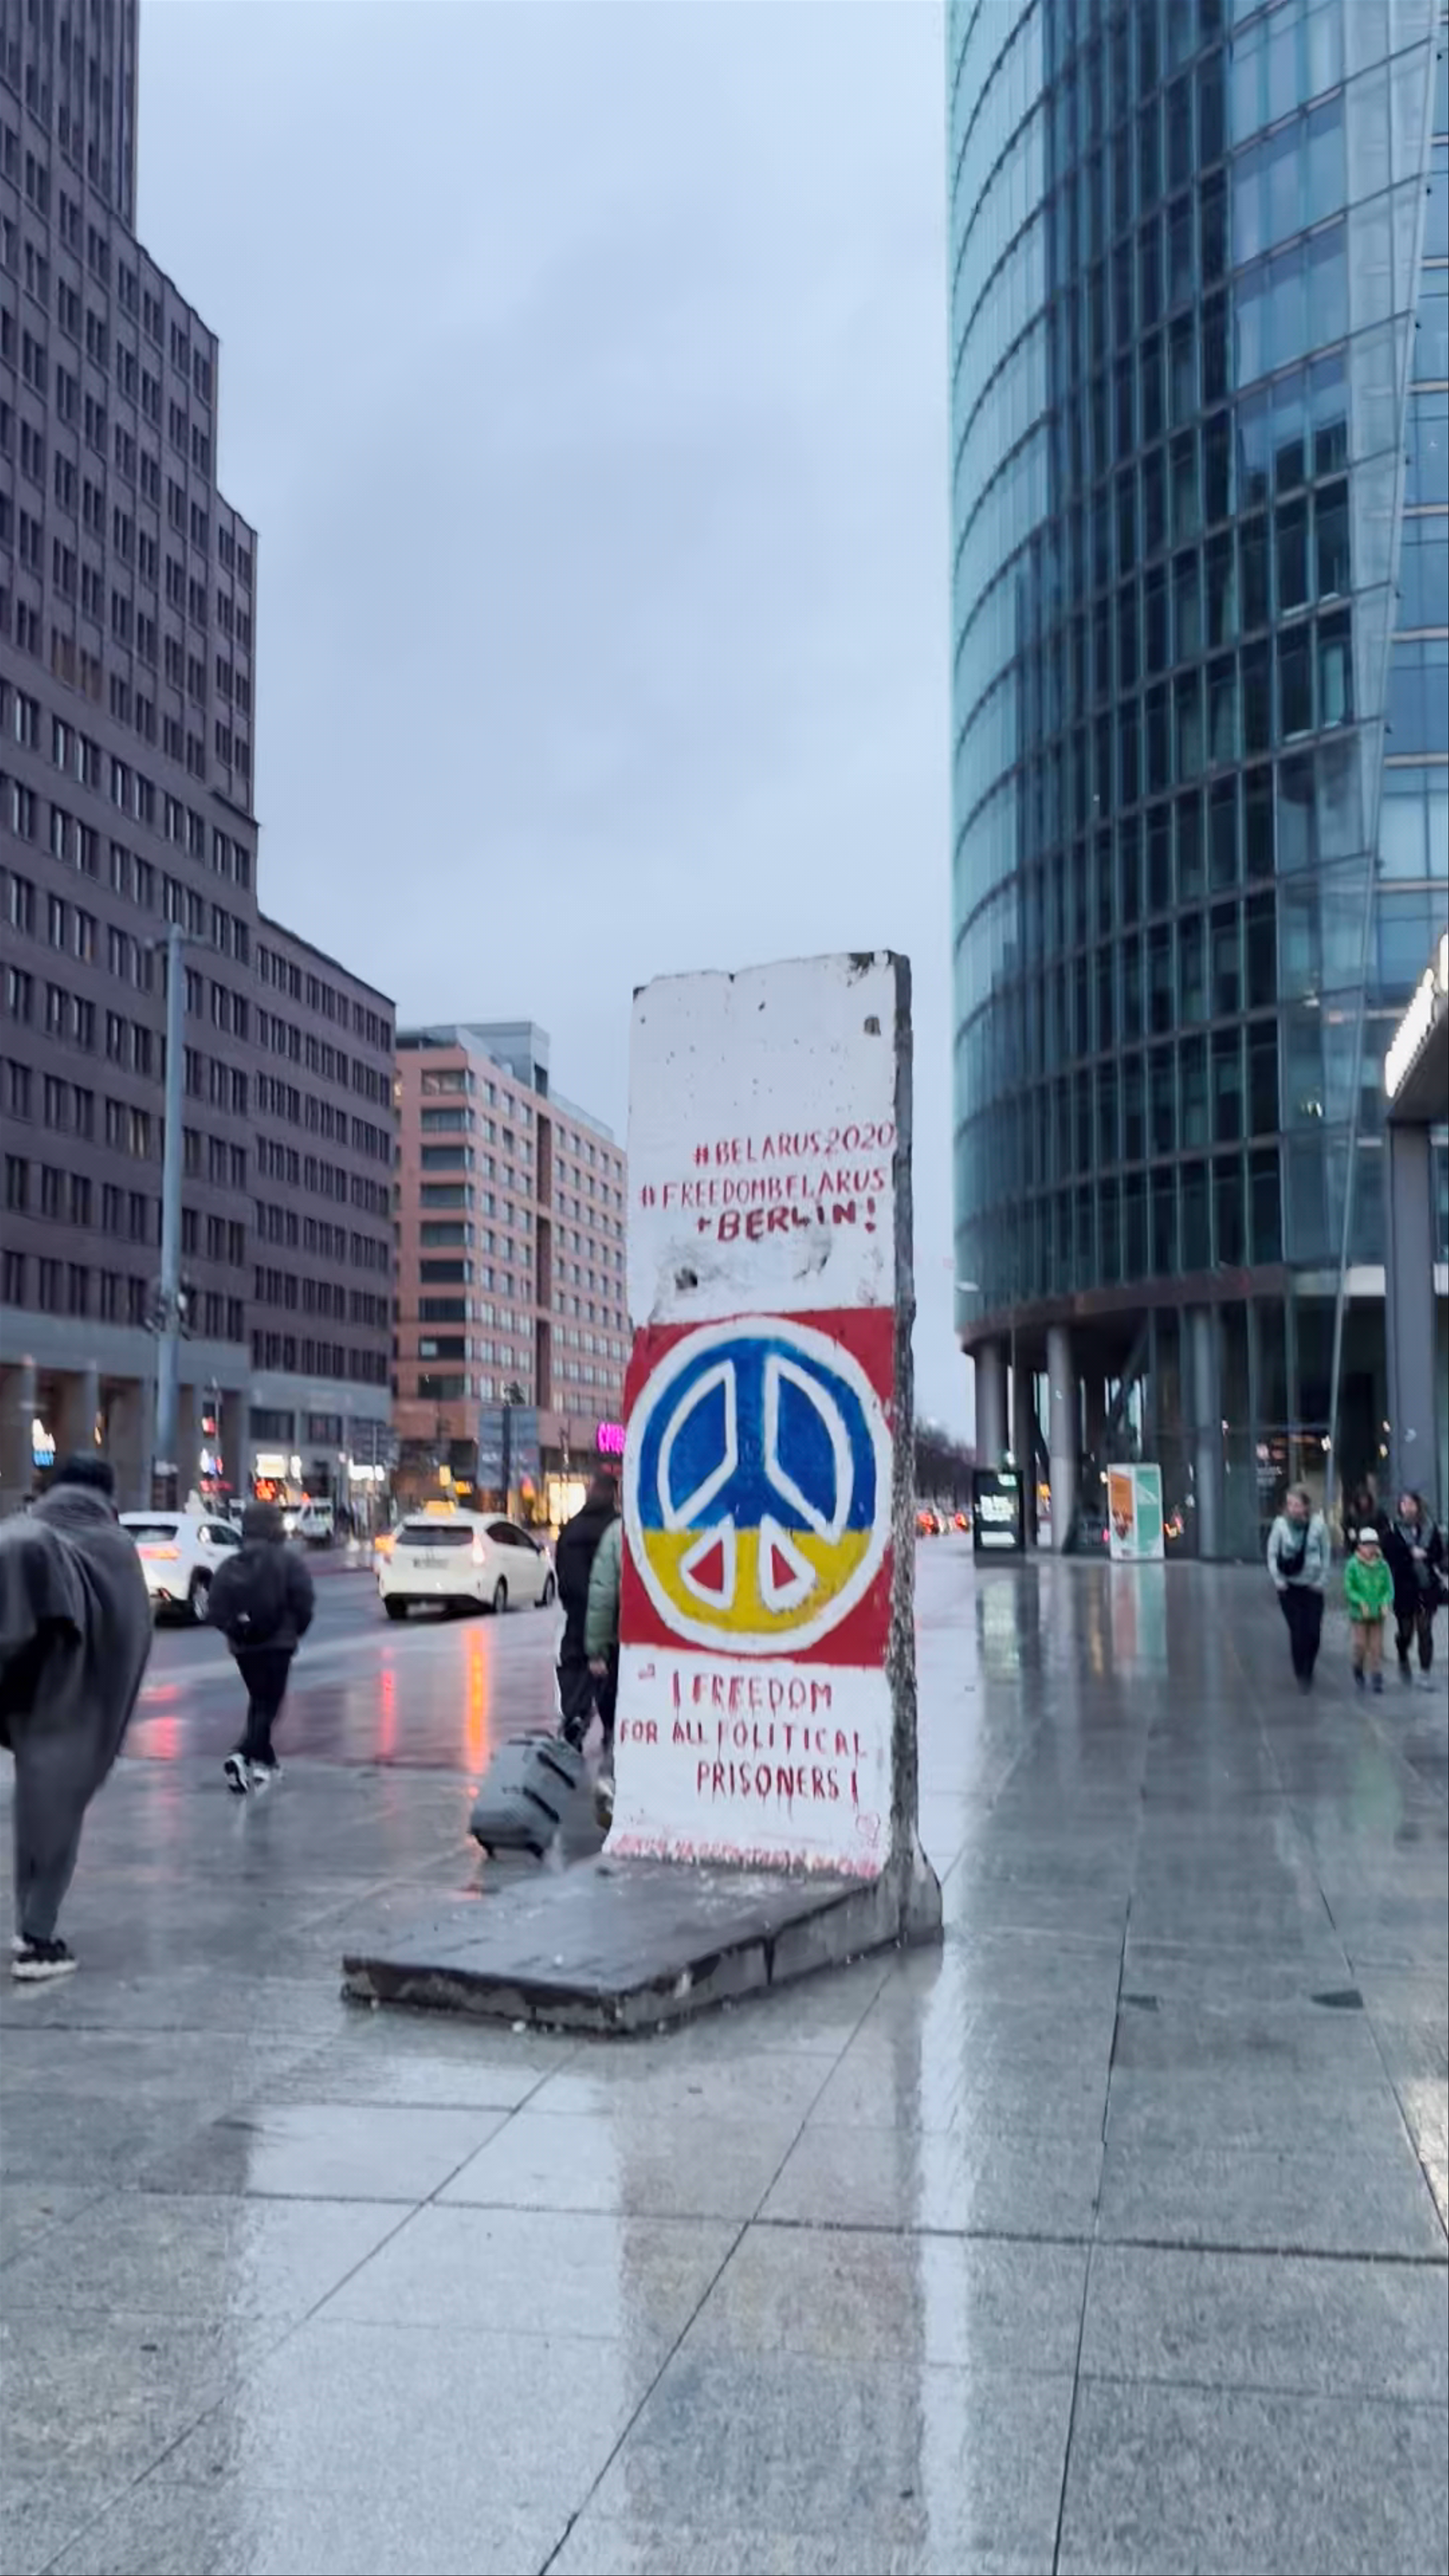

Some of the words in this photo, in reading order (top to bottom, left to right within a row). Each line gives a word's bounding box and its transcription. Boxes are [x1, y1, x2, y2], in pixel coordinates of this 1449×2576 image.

[640, 1169, 885, 1208] #FREEDOMBELARUS
[620, 1720, 657, 1745] FOR
[673, 1721, 708, 1744] ALL
[717, 1720, 867, 1757] POLITICAL
